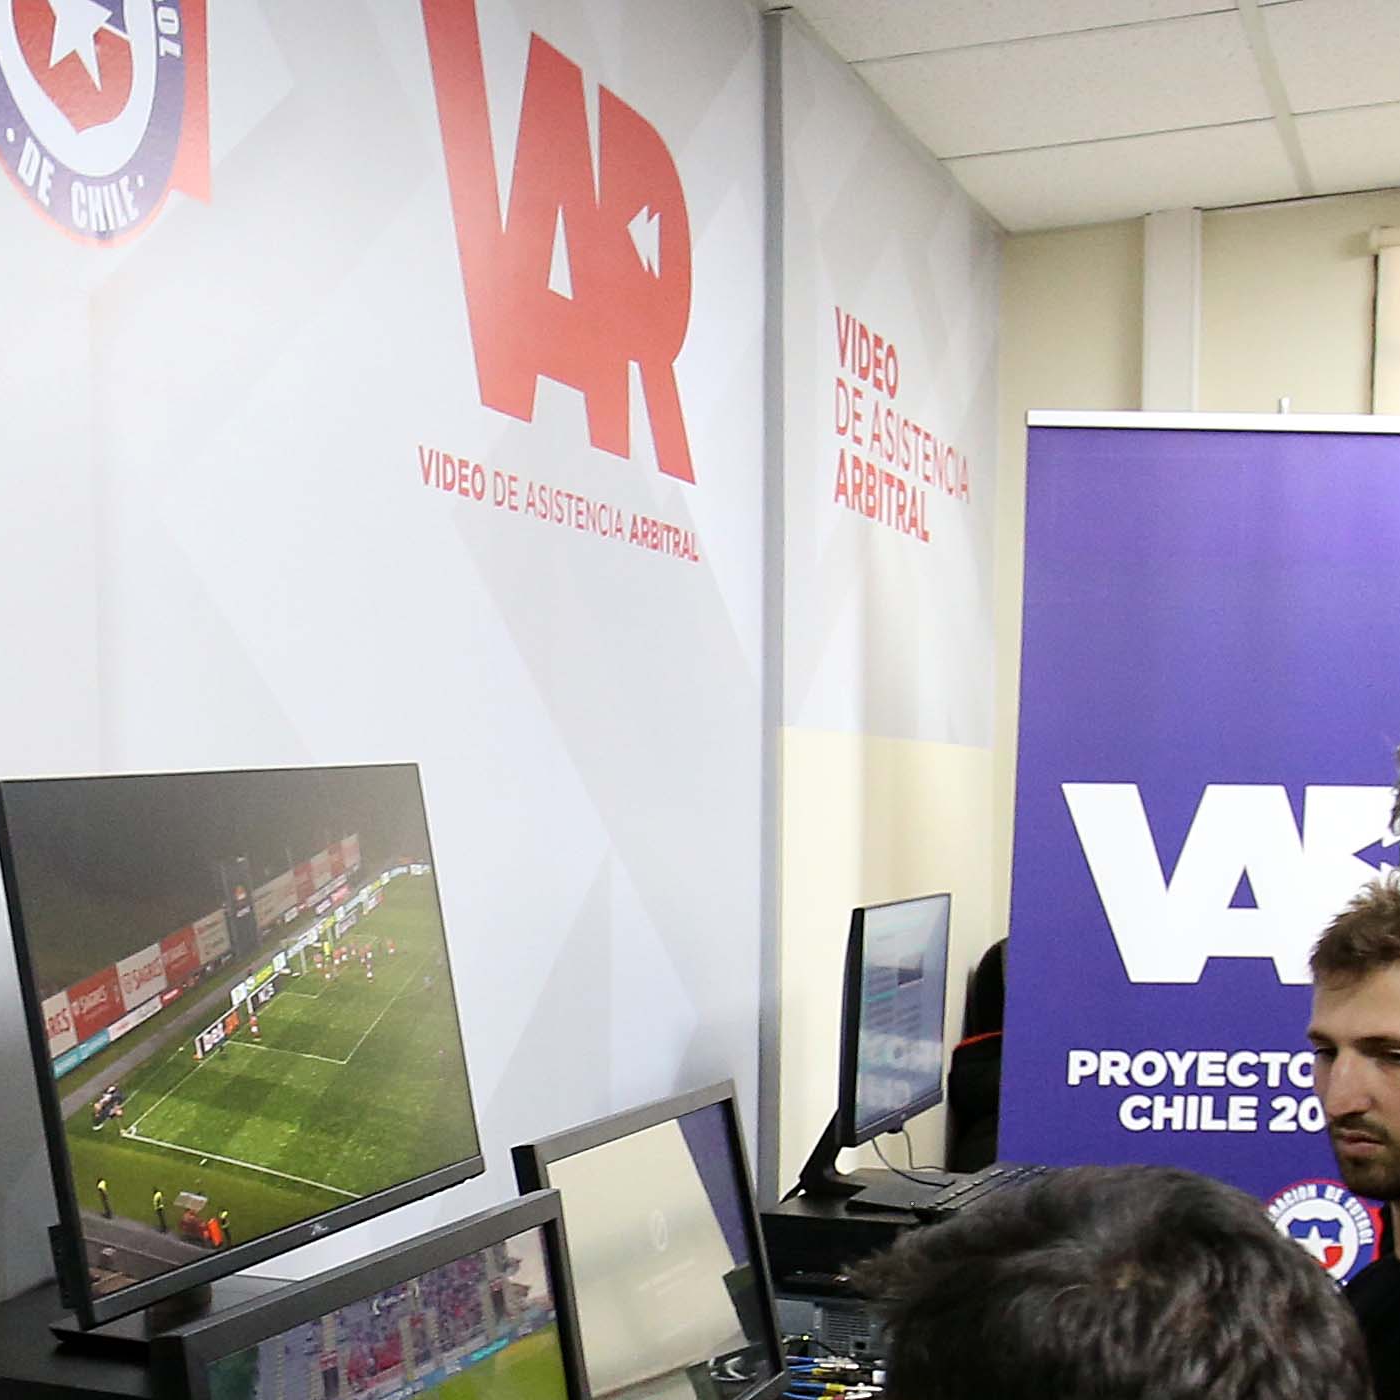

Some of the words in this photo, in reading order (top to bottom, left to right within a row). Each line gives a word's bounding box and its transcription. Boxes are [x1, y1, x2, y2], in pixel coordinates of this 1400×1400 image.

[17, 137, 55, 206] DE
[70, 174, 140, 232] CHILE
[420, 0, 697, 485] VAR
[834, 306, 898, 400] VIDEO
[835, 377, 863, 446] DE
[869, 399, 971, 504] ASISTENCIA
[417, 444, 487, 502] VIDEO
[493, 470, 519, 511] DE
[524, 481, 626, 542] ASISTENCIA
[628, 514, 699, 562] ARBITRAL
[834, 447, 930, 543] ARBITRAL
[1067, 1049, 1315, 1088] PROYECTO
[1118, 1095, 1259, 1131] CHILE
[1268, 1095, 1327, 1132] 20
